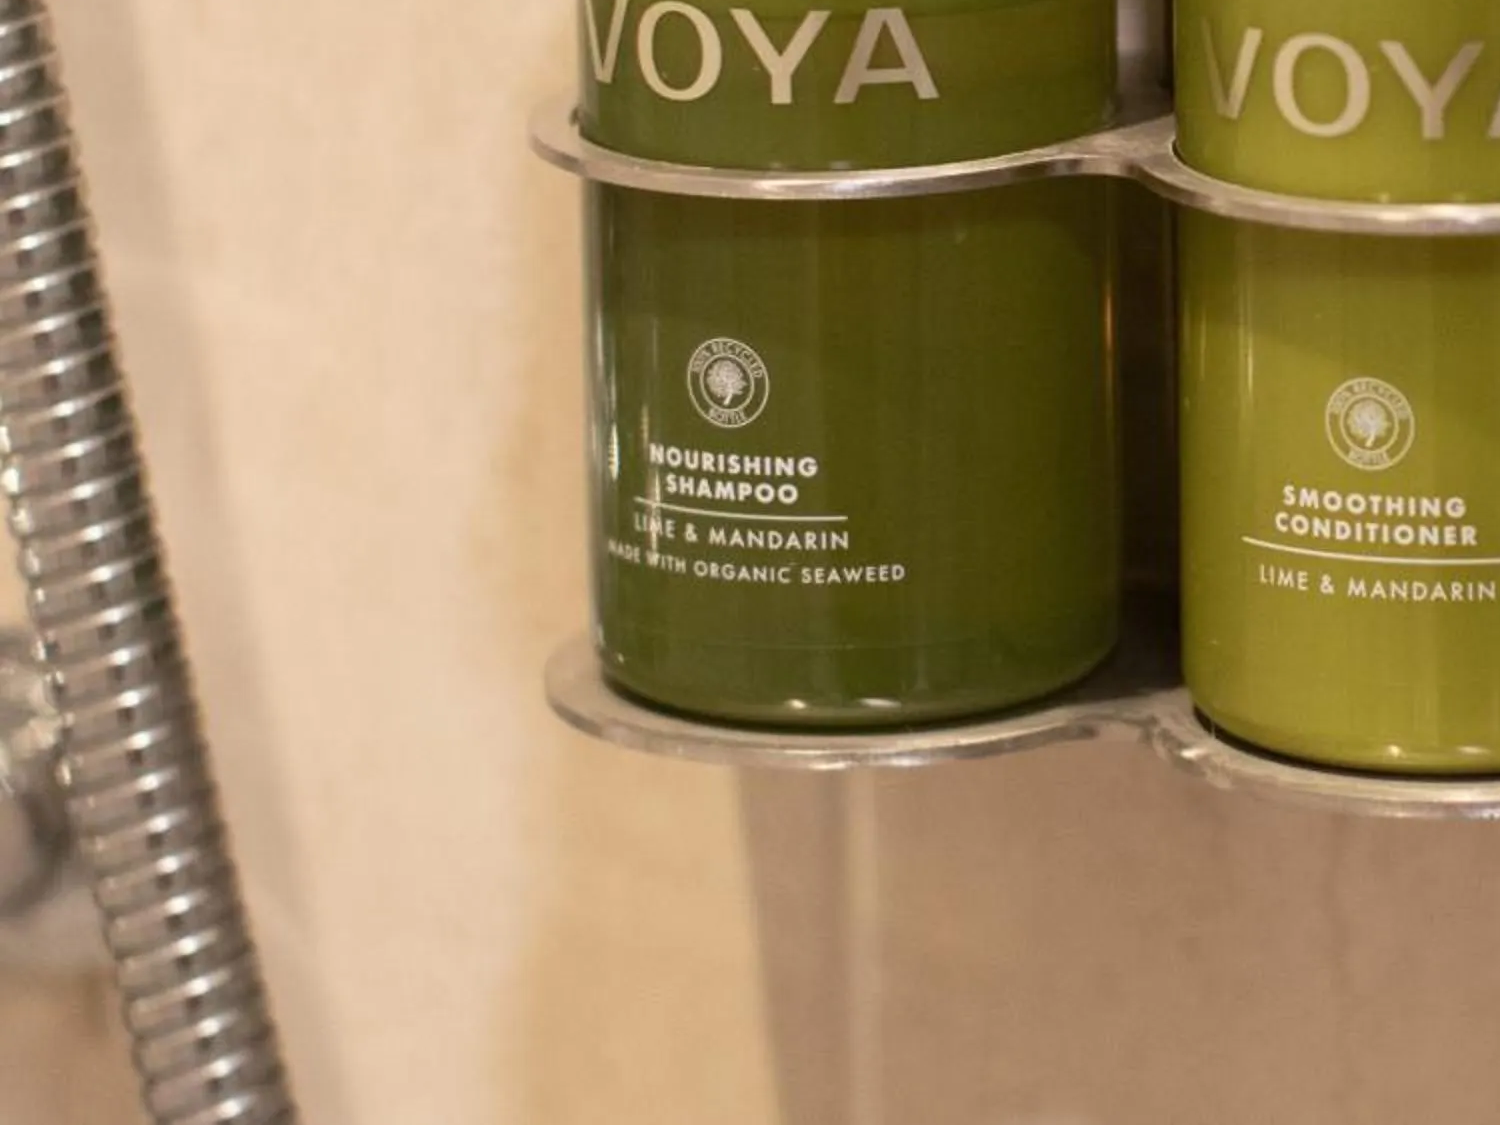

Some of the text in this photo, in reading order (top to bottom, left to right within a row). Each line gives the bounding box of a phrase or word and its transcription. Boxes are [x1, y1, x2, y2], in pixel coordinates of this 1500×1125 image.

[650, 442, 818, 477] NOURISHING
[666, 474, 799, 504] SHAMPOO
[1282, 485, 1466, 518] SMOOTHING
[633, 512, 849, 551] LIME & MANDARIN
[1275, 512, 1478, 546] CONDITIONER
[608, 539, 905, 584] MADE WITH ORGANIC SEAWEED
[1259, 564, 1497, 601] LIME & MANDARIN
